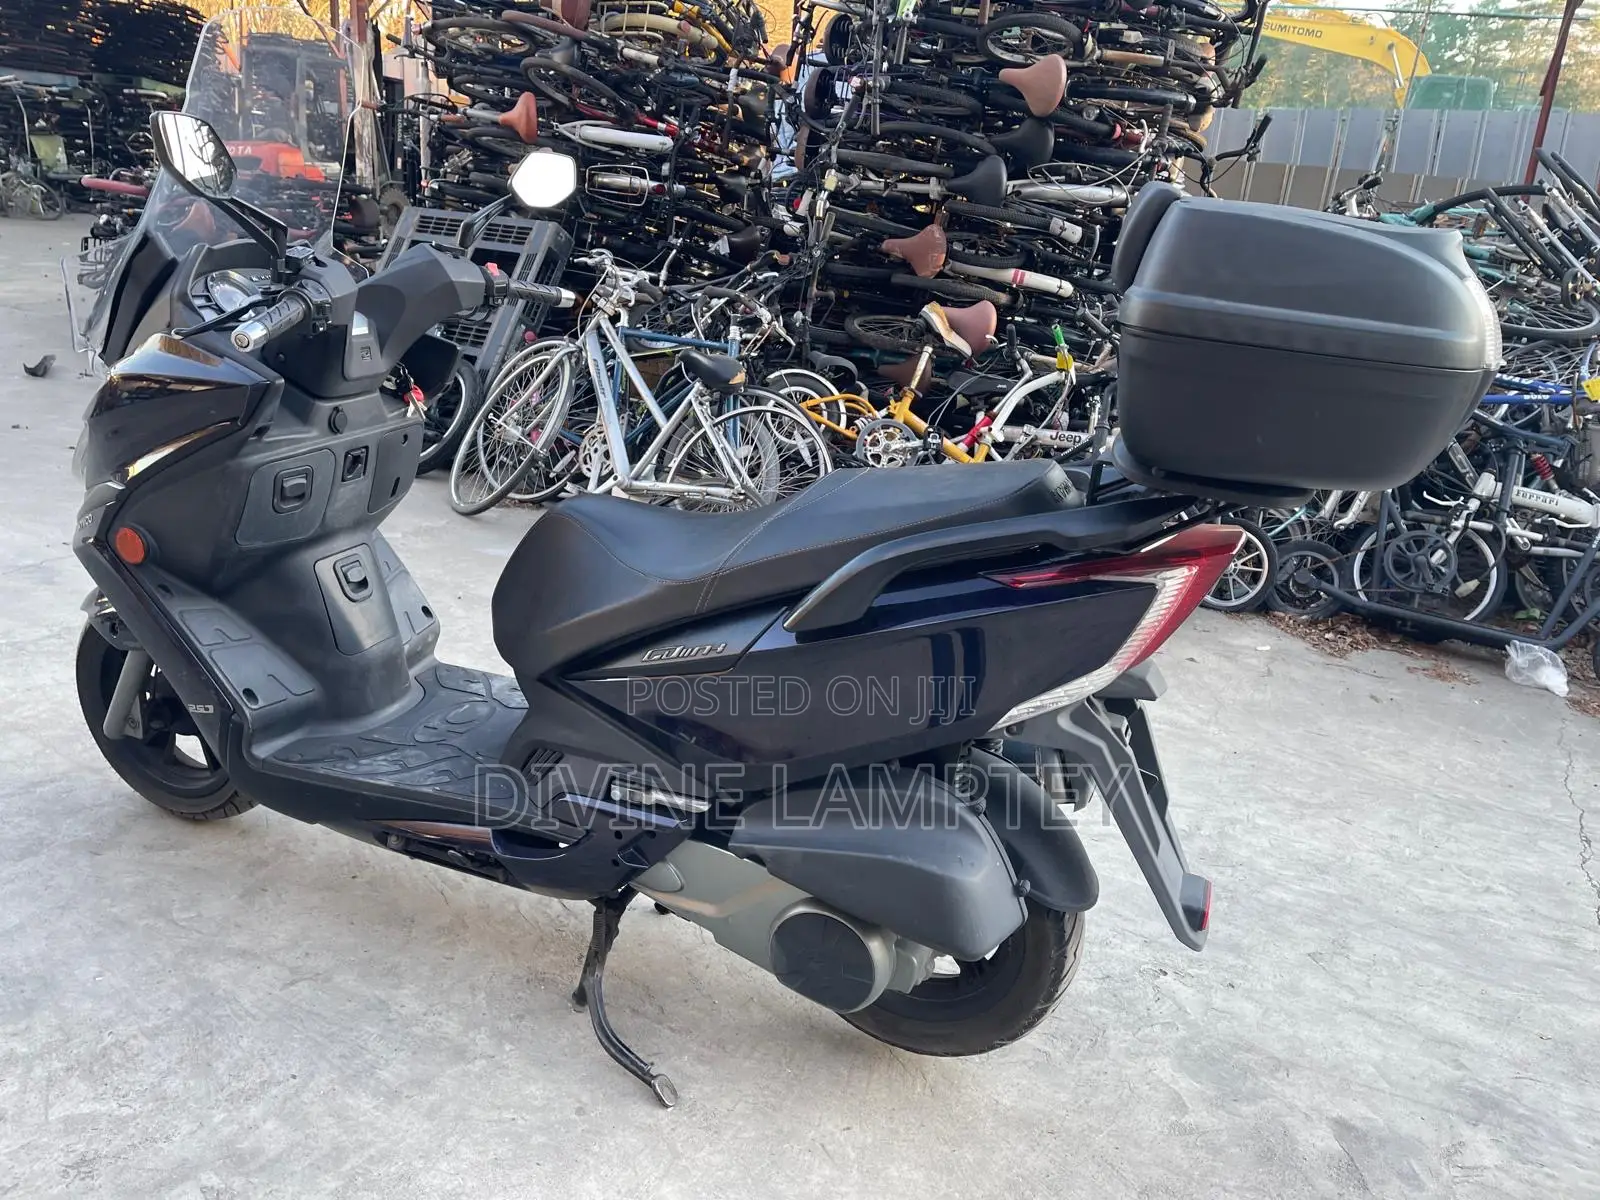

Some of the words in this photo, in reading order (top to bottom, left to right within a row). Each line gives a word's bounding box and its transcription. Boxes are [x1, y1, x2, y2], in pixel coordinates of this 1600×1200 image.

[1263, 22, 1323, 38] SUMITOMO
[1050, 431, 1082, 445] Jeep
[1515, 489, 1559, 506] Ferrari
[187, 703, 214, 714] 250
